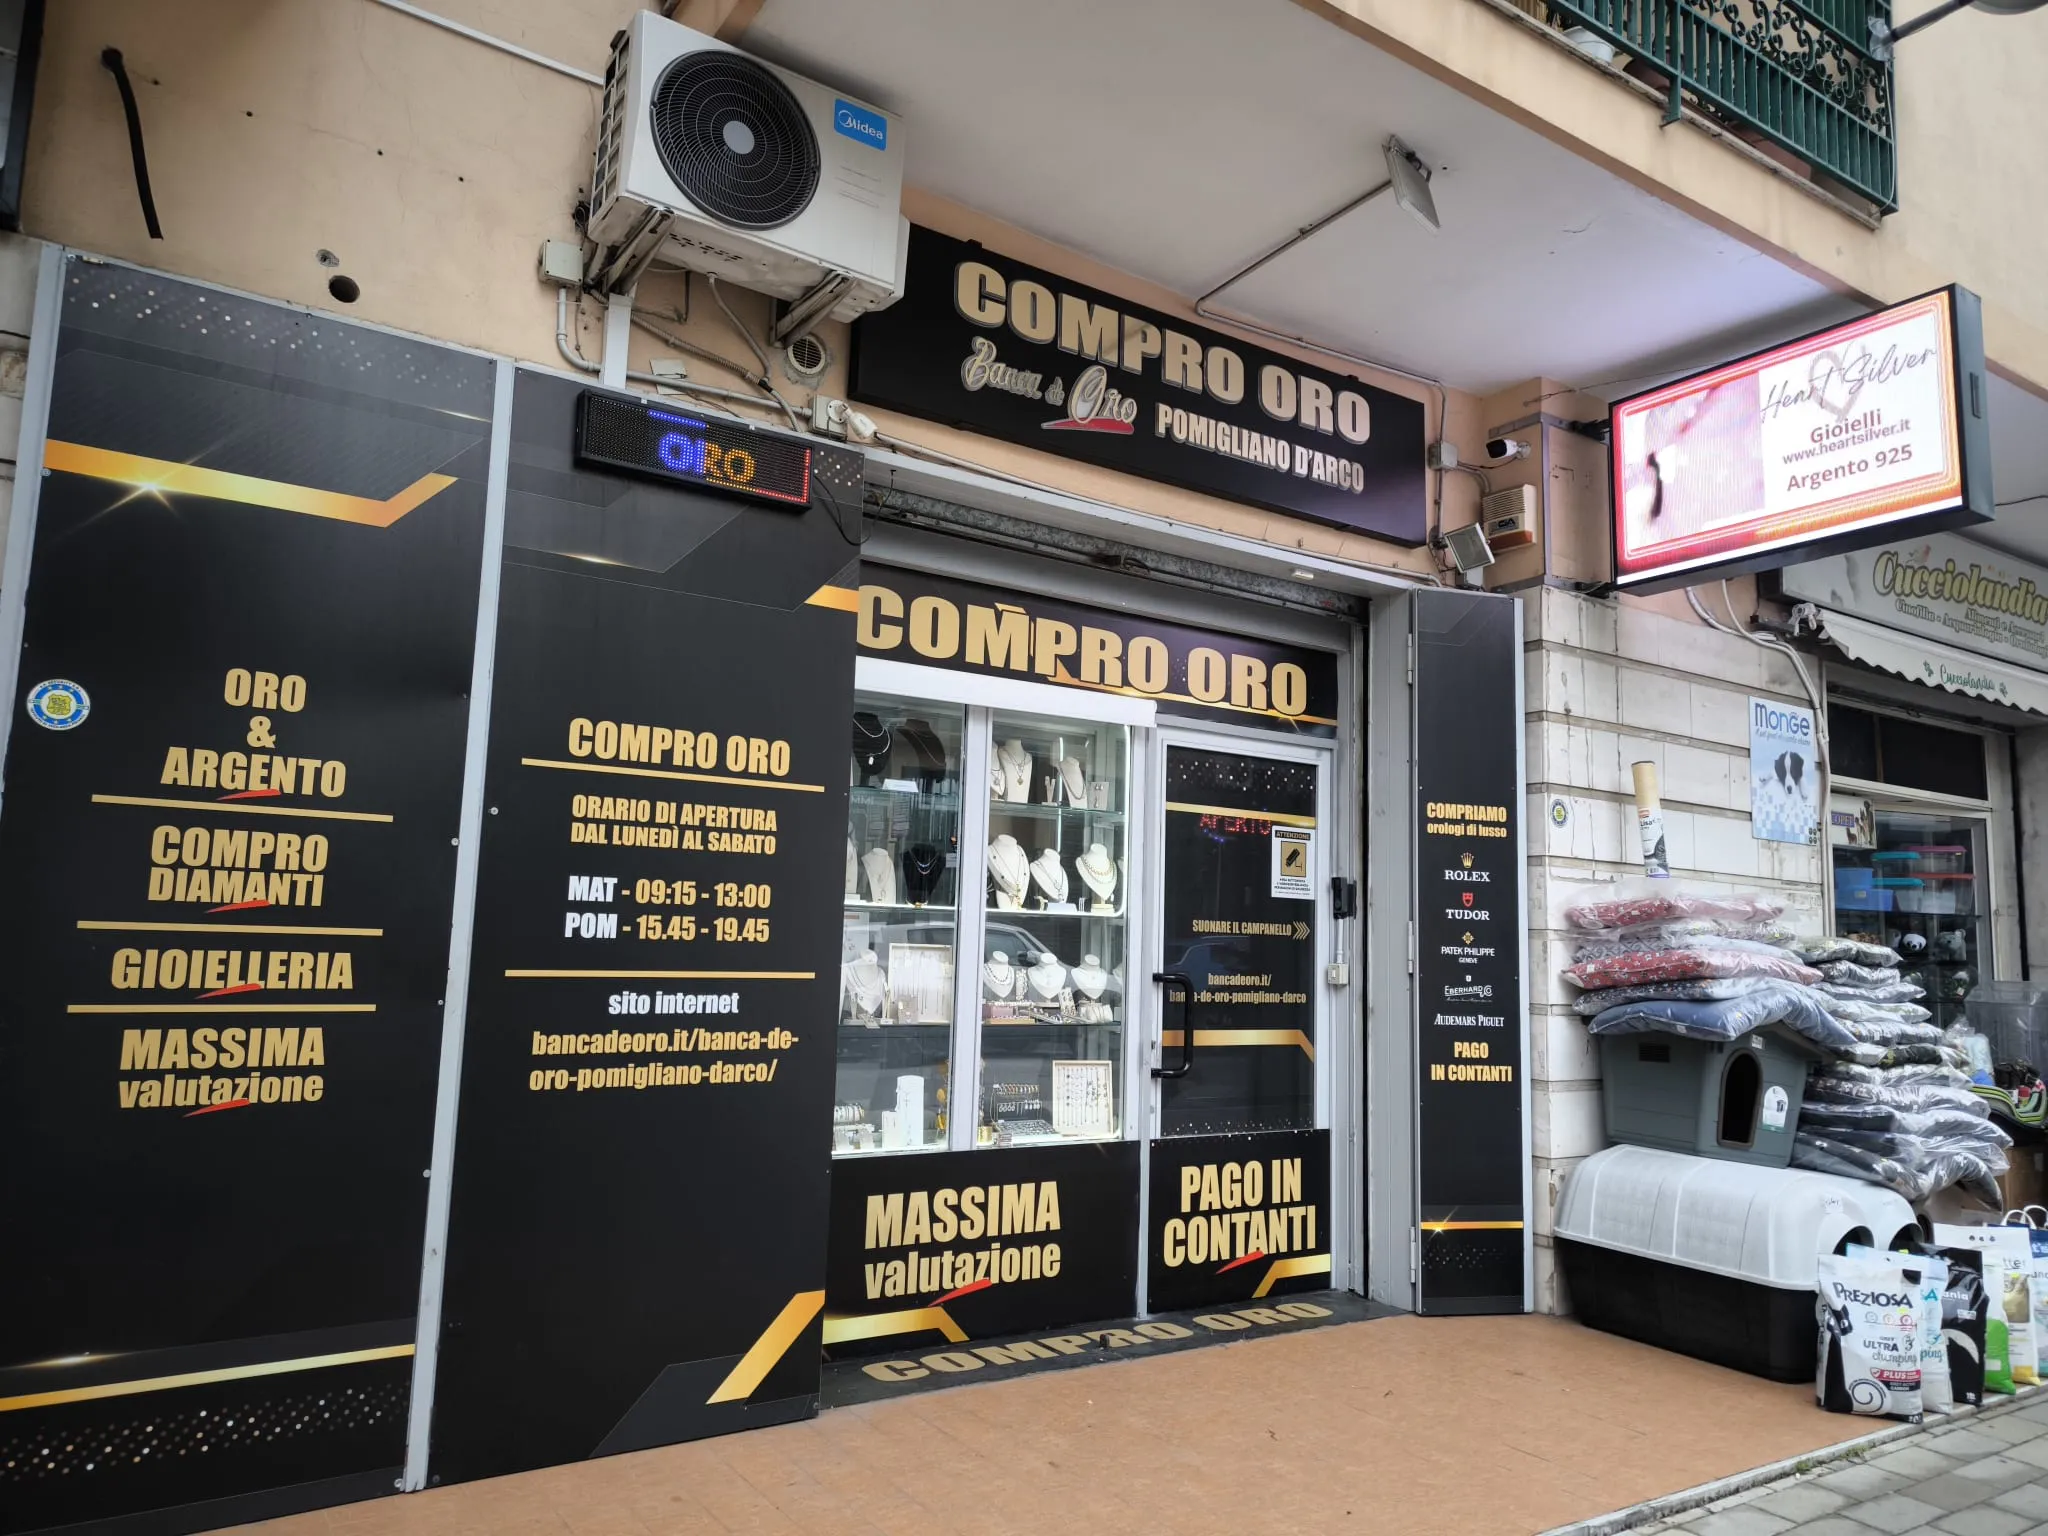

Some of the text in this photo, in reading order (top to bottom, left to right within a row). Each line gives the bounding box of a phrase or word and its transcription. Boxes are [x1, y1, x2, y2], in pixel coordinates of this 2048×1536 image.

[840, 111, 884, 139] Midea
[954, 261, 1371, 445] COMPRO ORO
[1068, 365, 1137, 423] Oro
[1760, 344, 1938, 424] Heart Silver
[1782, 419, 1911, 465] www.heartsilver.it
[1810, 409, 1882, 444] Gioielli
[1155, 402, 1364, 495] POMIGLIANO D'ARCO
[1787, 444, 1913, 491] Argento 925
[1873, 551, 2048, 625] Cucciolandia
[856, 584, 1307, 716] COMPRO ORO
[224, 668, 306, 713] ORO
[1940, 664, 1995, 691] Cucciolandia
[247, 716, 276, 748] &
[568, 718, 790, 777] COMPRO ORO
[160, 746, 347, 798] ARGENTO
[572, 794, 777, 832] ORARIO DI APERTURA
[1426, 802, 1507, 822] COMPRIAMO
[570, 822, 776, 855] DAL LUNEDÌ AL SABATO
[1427, 823, 1507, 838] orologi di lusso
[151, 825, 329, 872] COMPRO
[148, 867, 324, 907] DIAMANTI
[567, 875, 618, 903] MAT
[635, 878, 697, 906] 09:15
[713, 882, 771, 909] 13:00
[1444, 870, 1490, 882] ROLEX
[564, 912, 617, 939] POM
[636, 914, 696, 941] 15.45
[713, 917, 770, 943] 19.45
[1193, 919, 1292, 936] SUONARE IL CAMPANELLO
[1446, 909, 1490, 921] TUDOR
[1441, 946, 1495, 956] PATEK PHILIPPE
[111, 948, 353, 990] GIOIELLERIA
[1208, 973, 1271, 986] bancadeoro.it/
[608, 990, 739, 1015] sito internet
[1170, 990, 1306, 1004] bana-de-oro-pomigliano-darco
[1434, 1013, 1504, 1027] AUDEMARS PIGUET
[119, 1027, 325, 1070] MASSIMA
[531, 1027, 799, 1056] bancadeoro.it/banca-de-
[1454, 1041, 1489, 1059] PAGO
[529, 1059, 778, 1091] oro-pomigliano-darco/
[1431, 1064, 1512, 1082] IN CONTANTI
[119, 1072, 324, 1109] valutazione
[1180, 1158, 1302, 1213] PAGO IN
[865, 1181, 1061, 1249] MASSIMA
[1163, 1205, 1316, 1268] CONTANTI
[865, 1242, 1061, 1299] valutazione
[1833, 1282, 1914, 1308] PREZIOSA
[861, 1302, 1334, 1382] COMPRO ORO
[1863, 1339, 1899, 1352] ULTRA
[1883, 1371, 1907, 1380] PLUS
